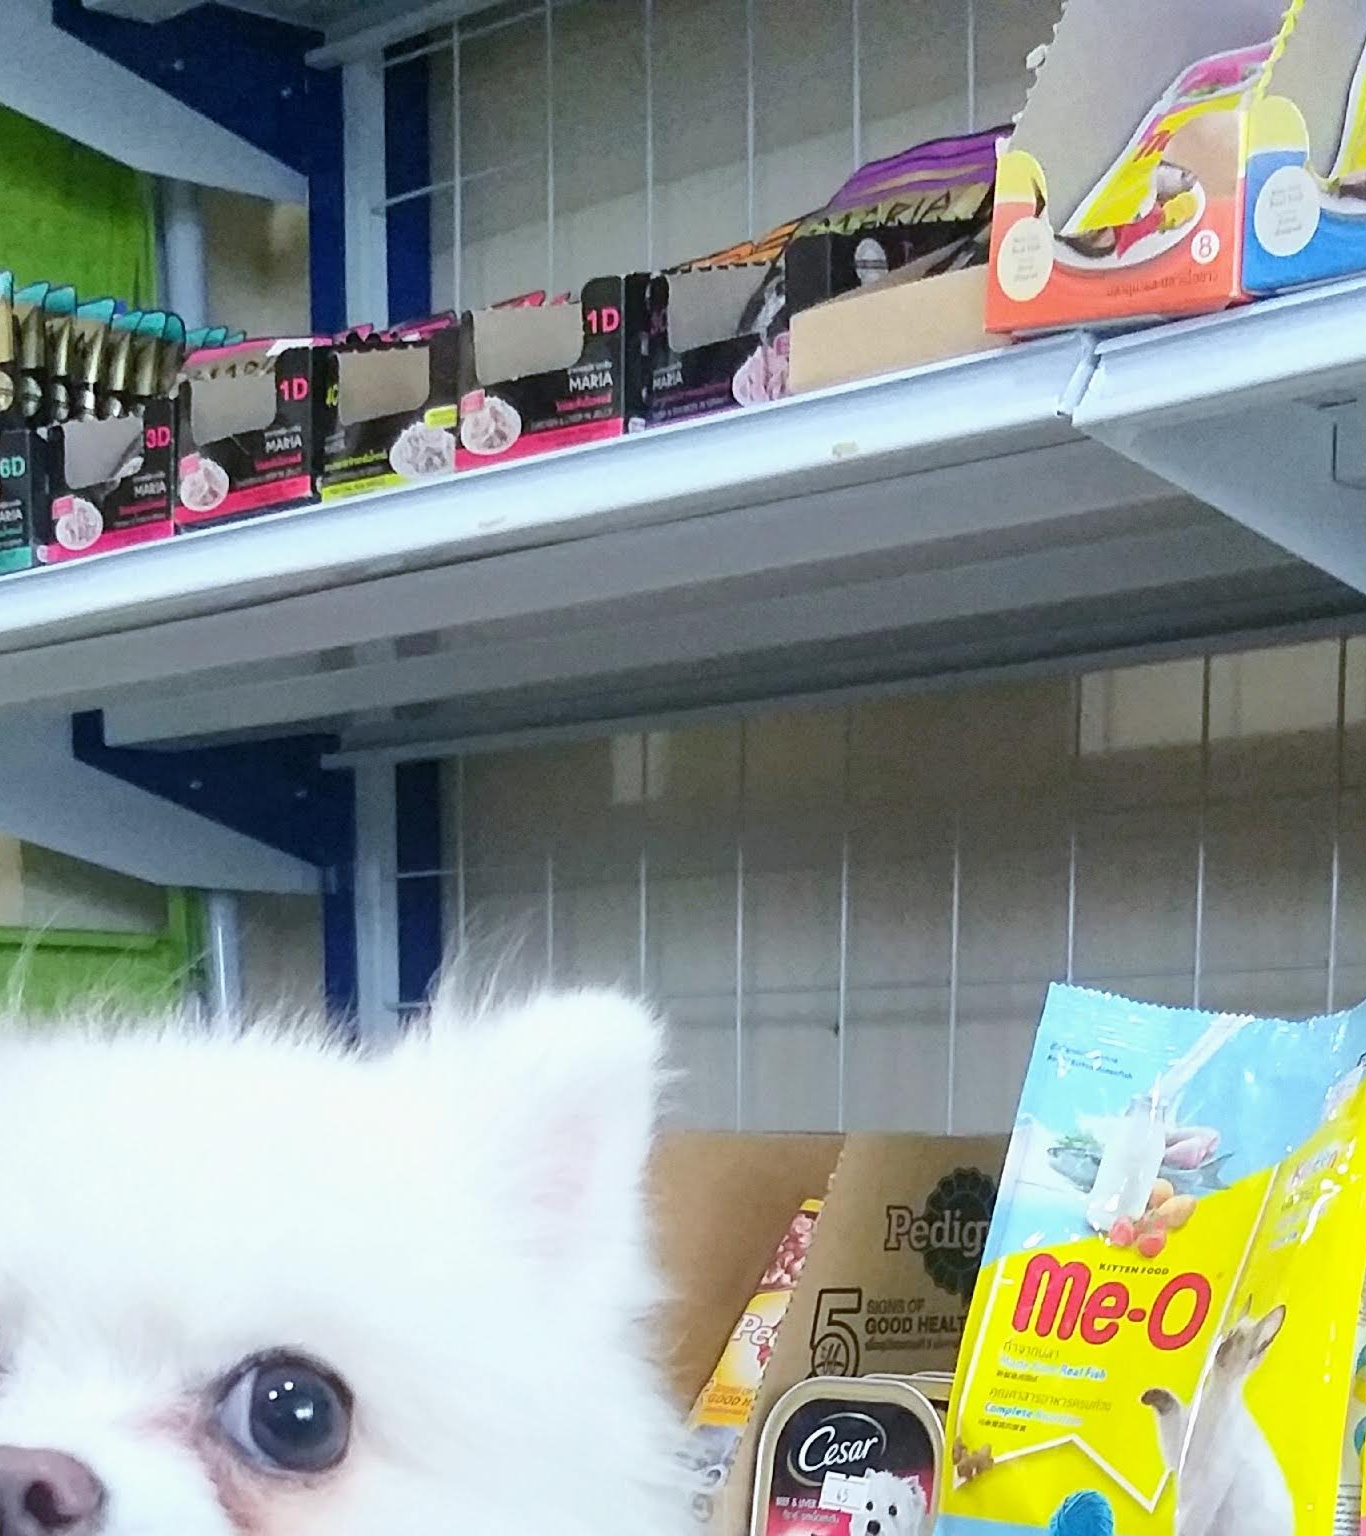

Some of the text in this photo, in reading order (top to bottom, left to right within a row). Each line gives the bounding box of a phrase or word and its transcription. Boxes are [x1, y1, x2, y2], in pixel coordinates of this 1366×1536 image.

[587, 308, 620, 334] 1D
[280, 377, 309, 401] 1D
[569, 370, 613, 392] MARIA
[145, 427, 171, 448] 3D
[265, 433, 302, 454] MARIA
[884, 1204, 985, 1258] Pedig
[1012, 1254, 1212, 1350] Me-O
[732, 1312, 778, 1347] Pe
[810, 1287, 863, 1378] 5
[906, 1299, 926, 1314] OF
[865, 1315, 968, 1335] GOOD HEALT
[1060, 1363, 1084, 1377] Real
[797, 1425, 880, 1473] Cesar
